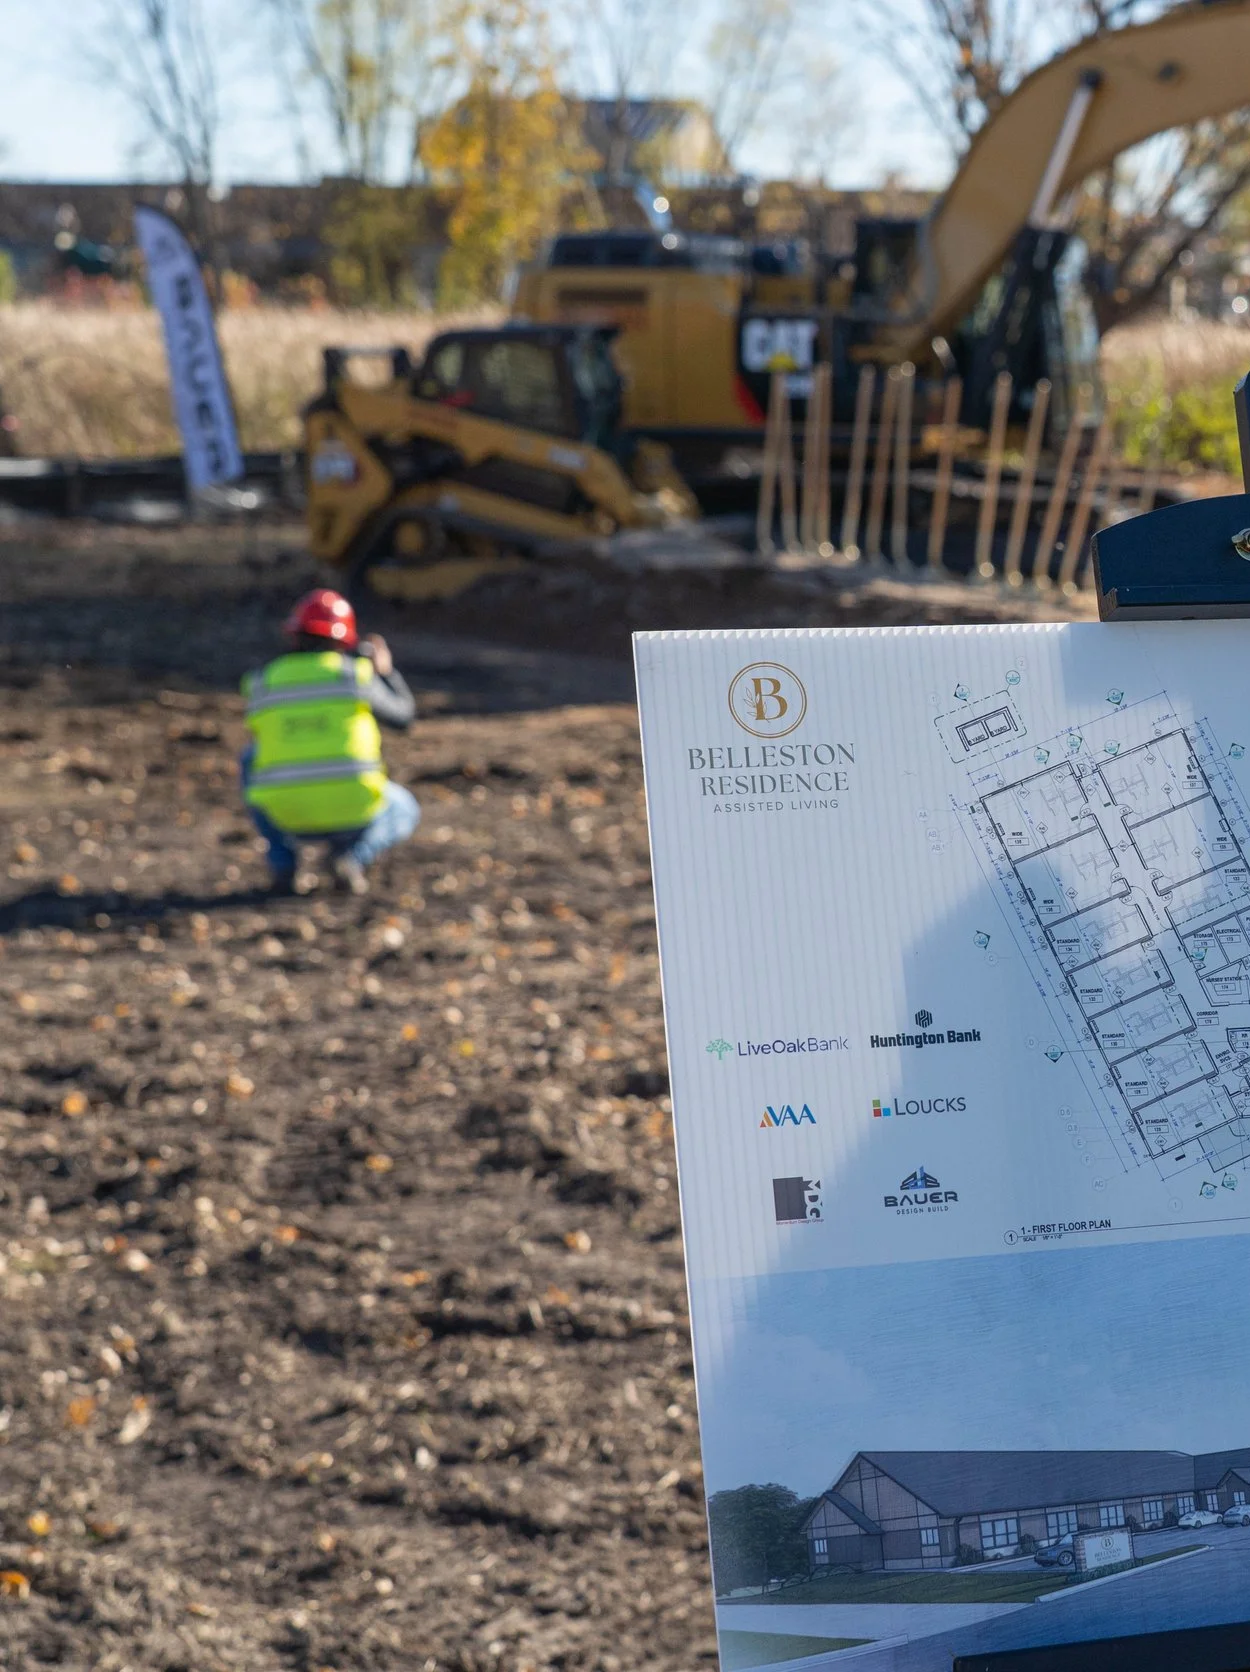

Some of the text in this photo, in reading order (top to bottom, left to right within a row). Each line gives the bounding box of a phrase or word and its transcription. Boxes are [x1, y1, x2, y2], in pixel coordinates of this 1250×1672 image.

[741, 318, 819, 373] CAT
[751, 677, 788, 721] B
[972, 734, 986, 744] YARD
[995, 725, 1008, 735] YARD
[687, 742, 856, 770] BELLESTON
[700, 771, 850, 796] RESIDENCE
[713, 799, 839, 814] ASSISTED LIVING
[870, 1029, 981, 1049] Huntington Bank
[1215, 1050, 1230, 1059] ENVIRO
[766, 1103, 817, 1127] VAA
[884, 1191, 959, 1208] BAUER
[1021, 1226, 1026, 1235] 1
[1032, 1224, 1056, 1234] FIRST
[1058, 1221, 1088, 1232] FLOOR
[1089, 1219, 1111, 1230] PLAN
